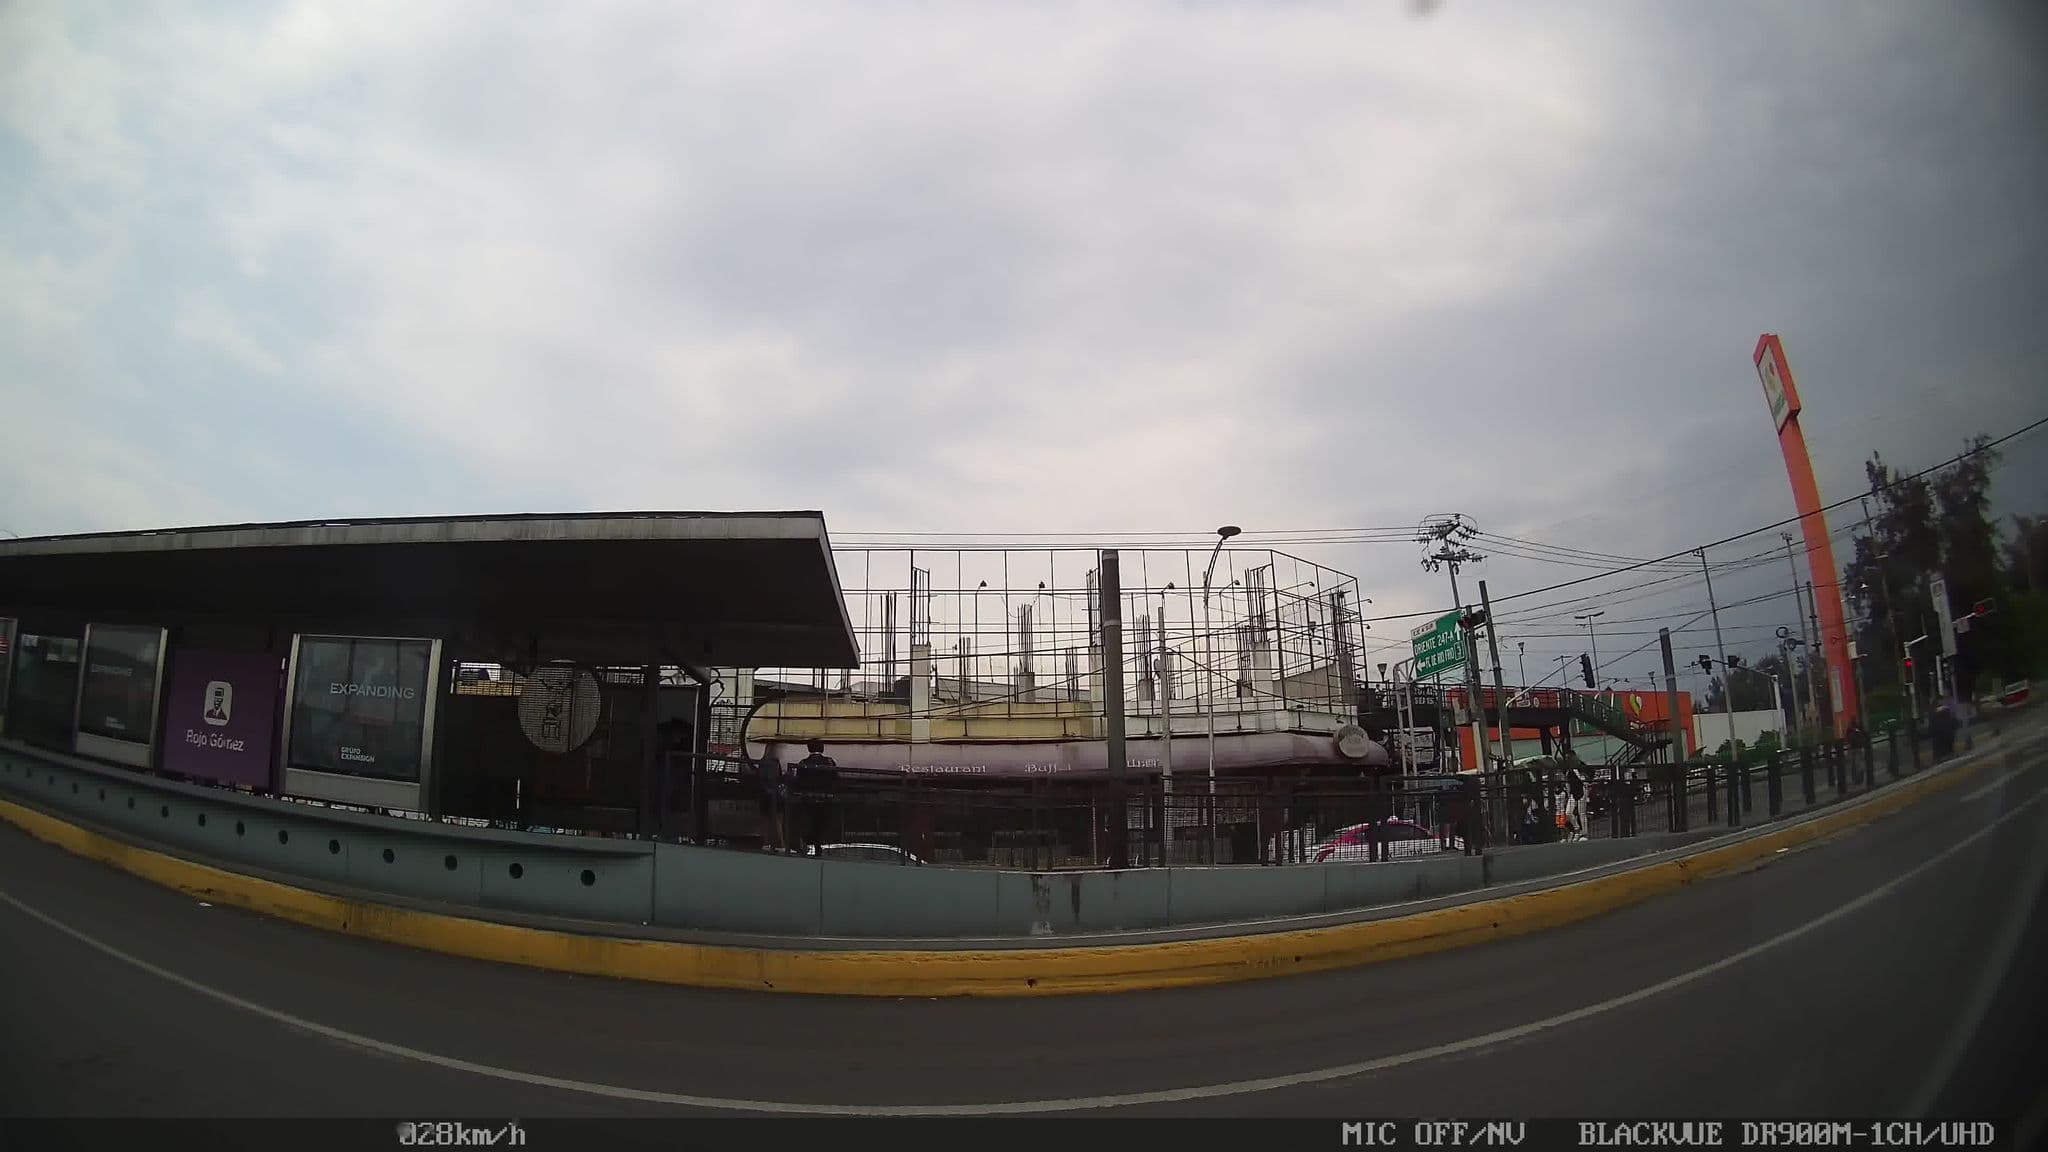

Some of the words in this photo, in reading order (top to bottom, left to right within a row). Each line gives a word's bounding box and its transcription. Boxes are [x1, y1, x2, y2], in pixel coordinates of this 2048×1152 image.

[1414, 638, 1437, 655] ORIENTE
[1437, 631, 1455, 646] 247-A
[330, 682, 415, 700] EXPANDING
[185, 729, 208, 747] Rojo
[209, 733, 244, 752] Gómez
[341, 746, 361, 755] GRUPO
[899, 763, 987, 774] Restaurant
